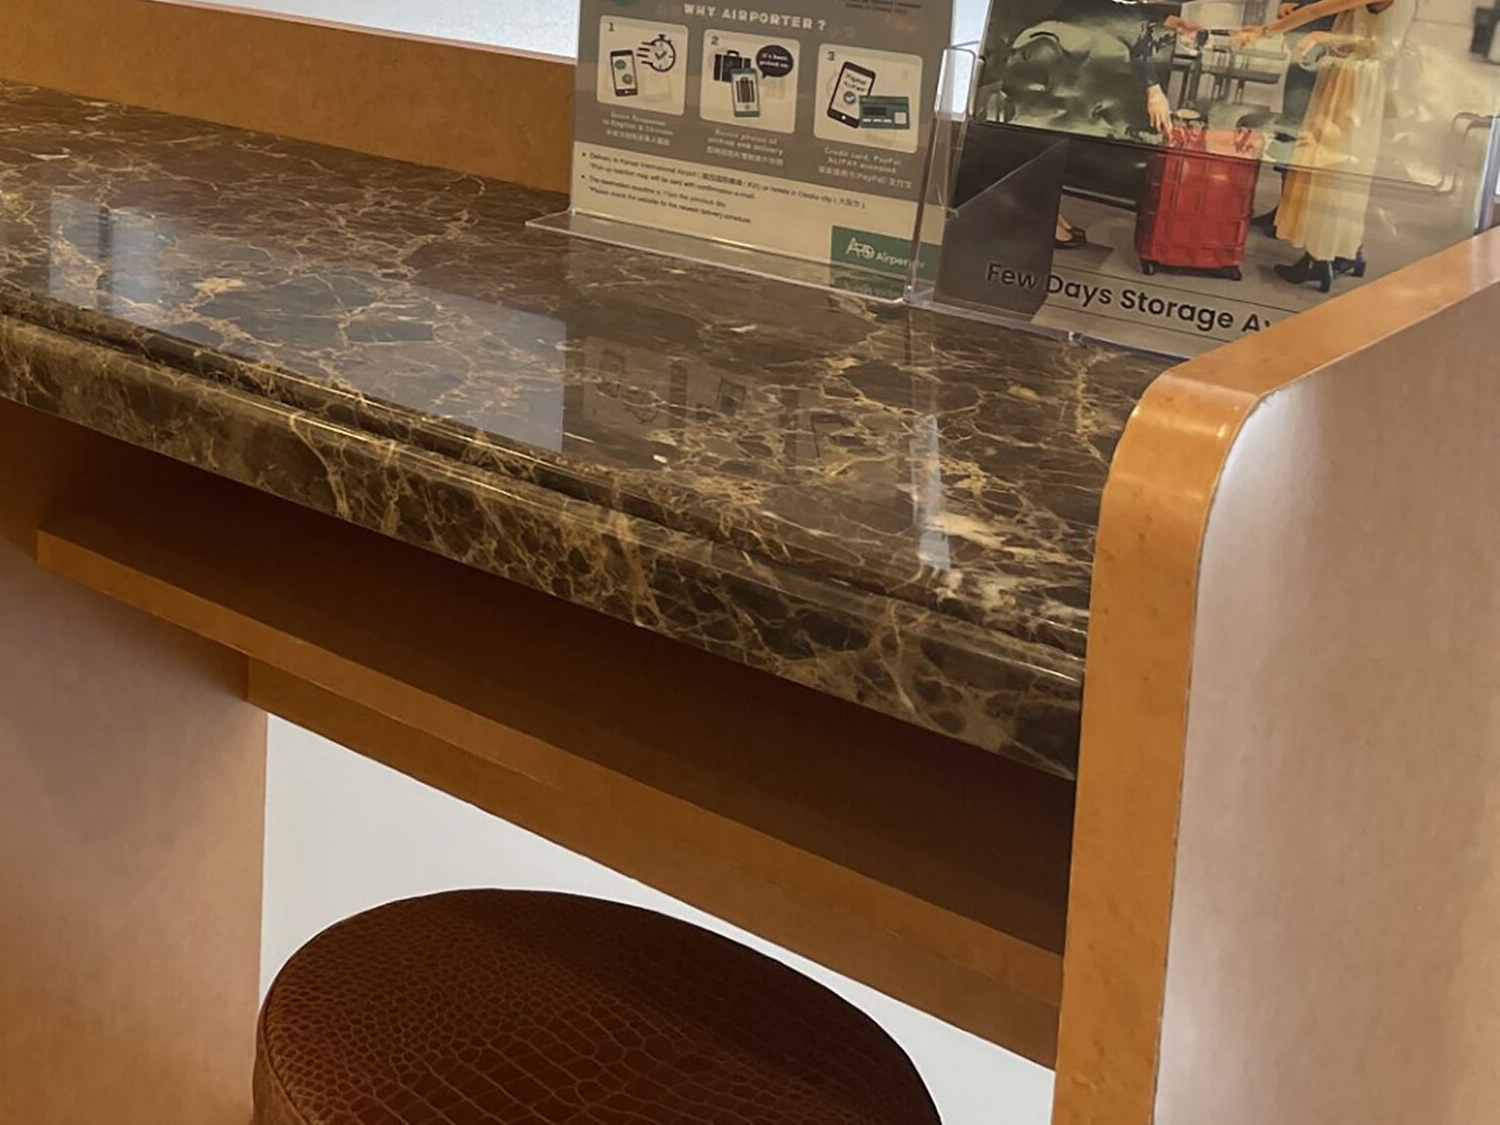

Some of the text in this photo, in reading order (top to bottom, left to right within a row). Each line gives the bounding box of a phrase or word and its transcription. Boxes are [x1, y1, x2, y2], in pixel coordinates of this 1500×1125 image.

[684, 3, 716, 17] WHY
[721, 8, 813, 30] AIRPORTER
[608, 22, 615, 32] 1
[711, 36, 719, 45] 2
[827, 52, 835, 61] 3
[986, 262, 1037, 290] Few
[1046, 274, 1113, 307] Days
[1120, 288, 1235, 332] Storage
